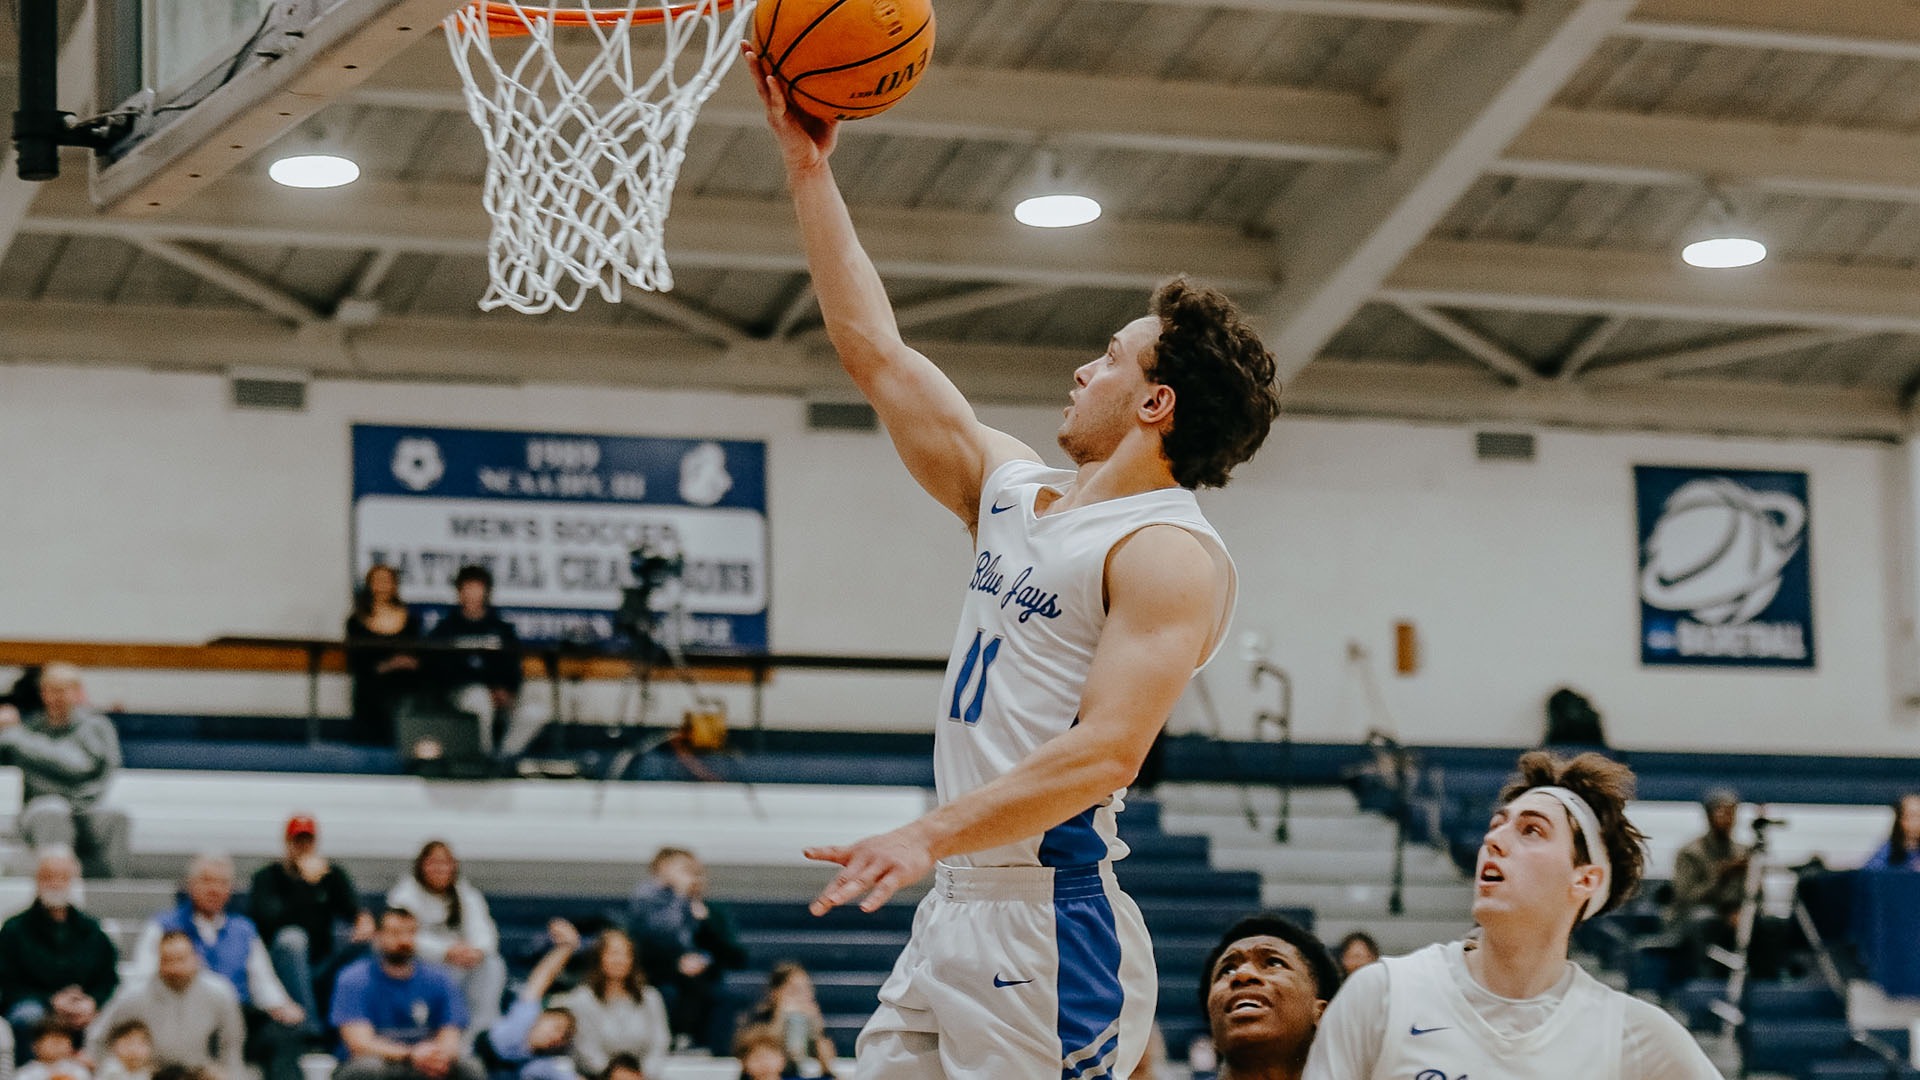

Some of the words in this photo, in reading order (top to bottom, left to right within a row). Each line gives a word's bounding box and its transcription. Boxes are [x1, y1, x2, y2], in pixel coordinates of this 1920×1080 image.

[876, 47, 928, 96] EVO
[450, 515, 539, 540] MEN'S
[554, 518, 680, 547] SOCCER
[969, 550, 1002, 596] Blue
[1001, 566, 1062, 623] Jays
[949, 626, 1004, 727] 11
